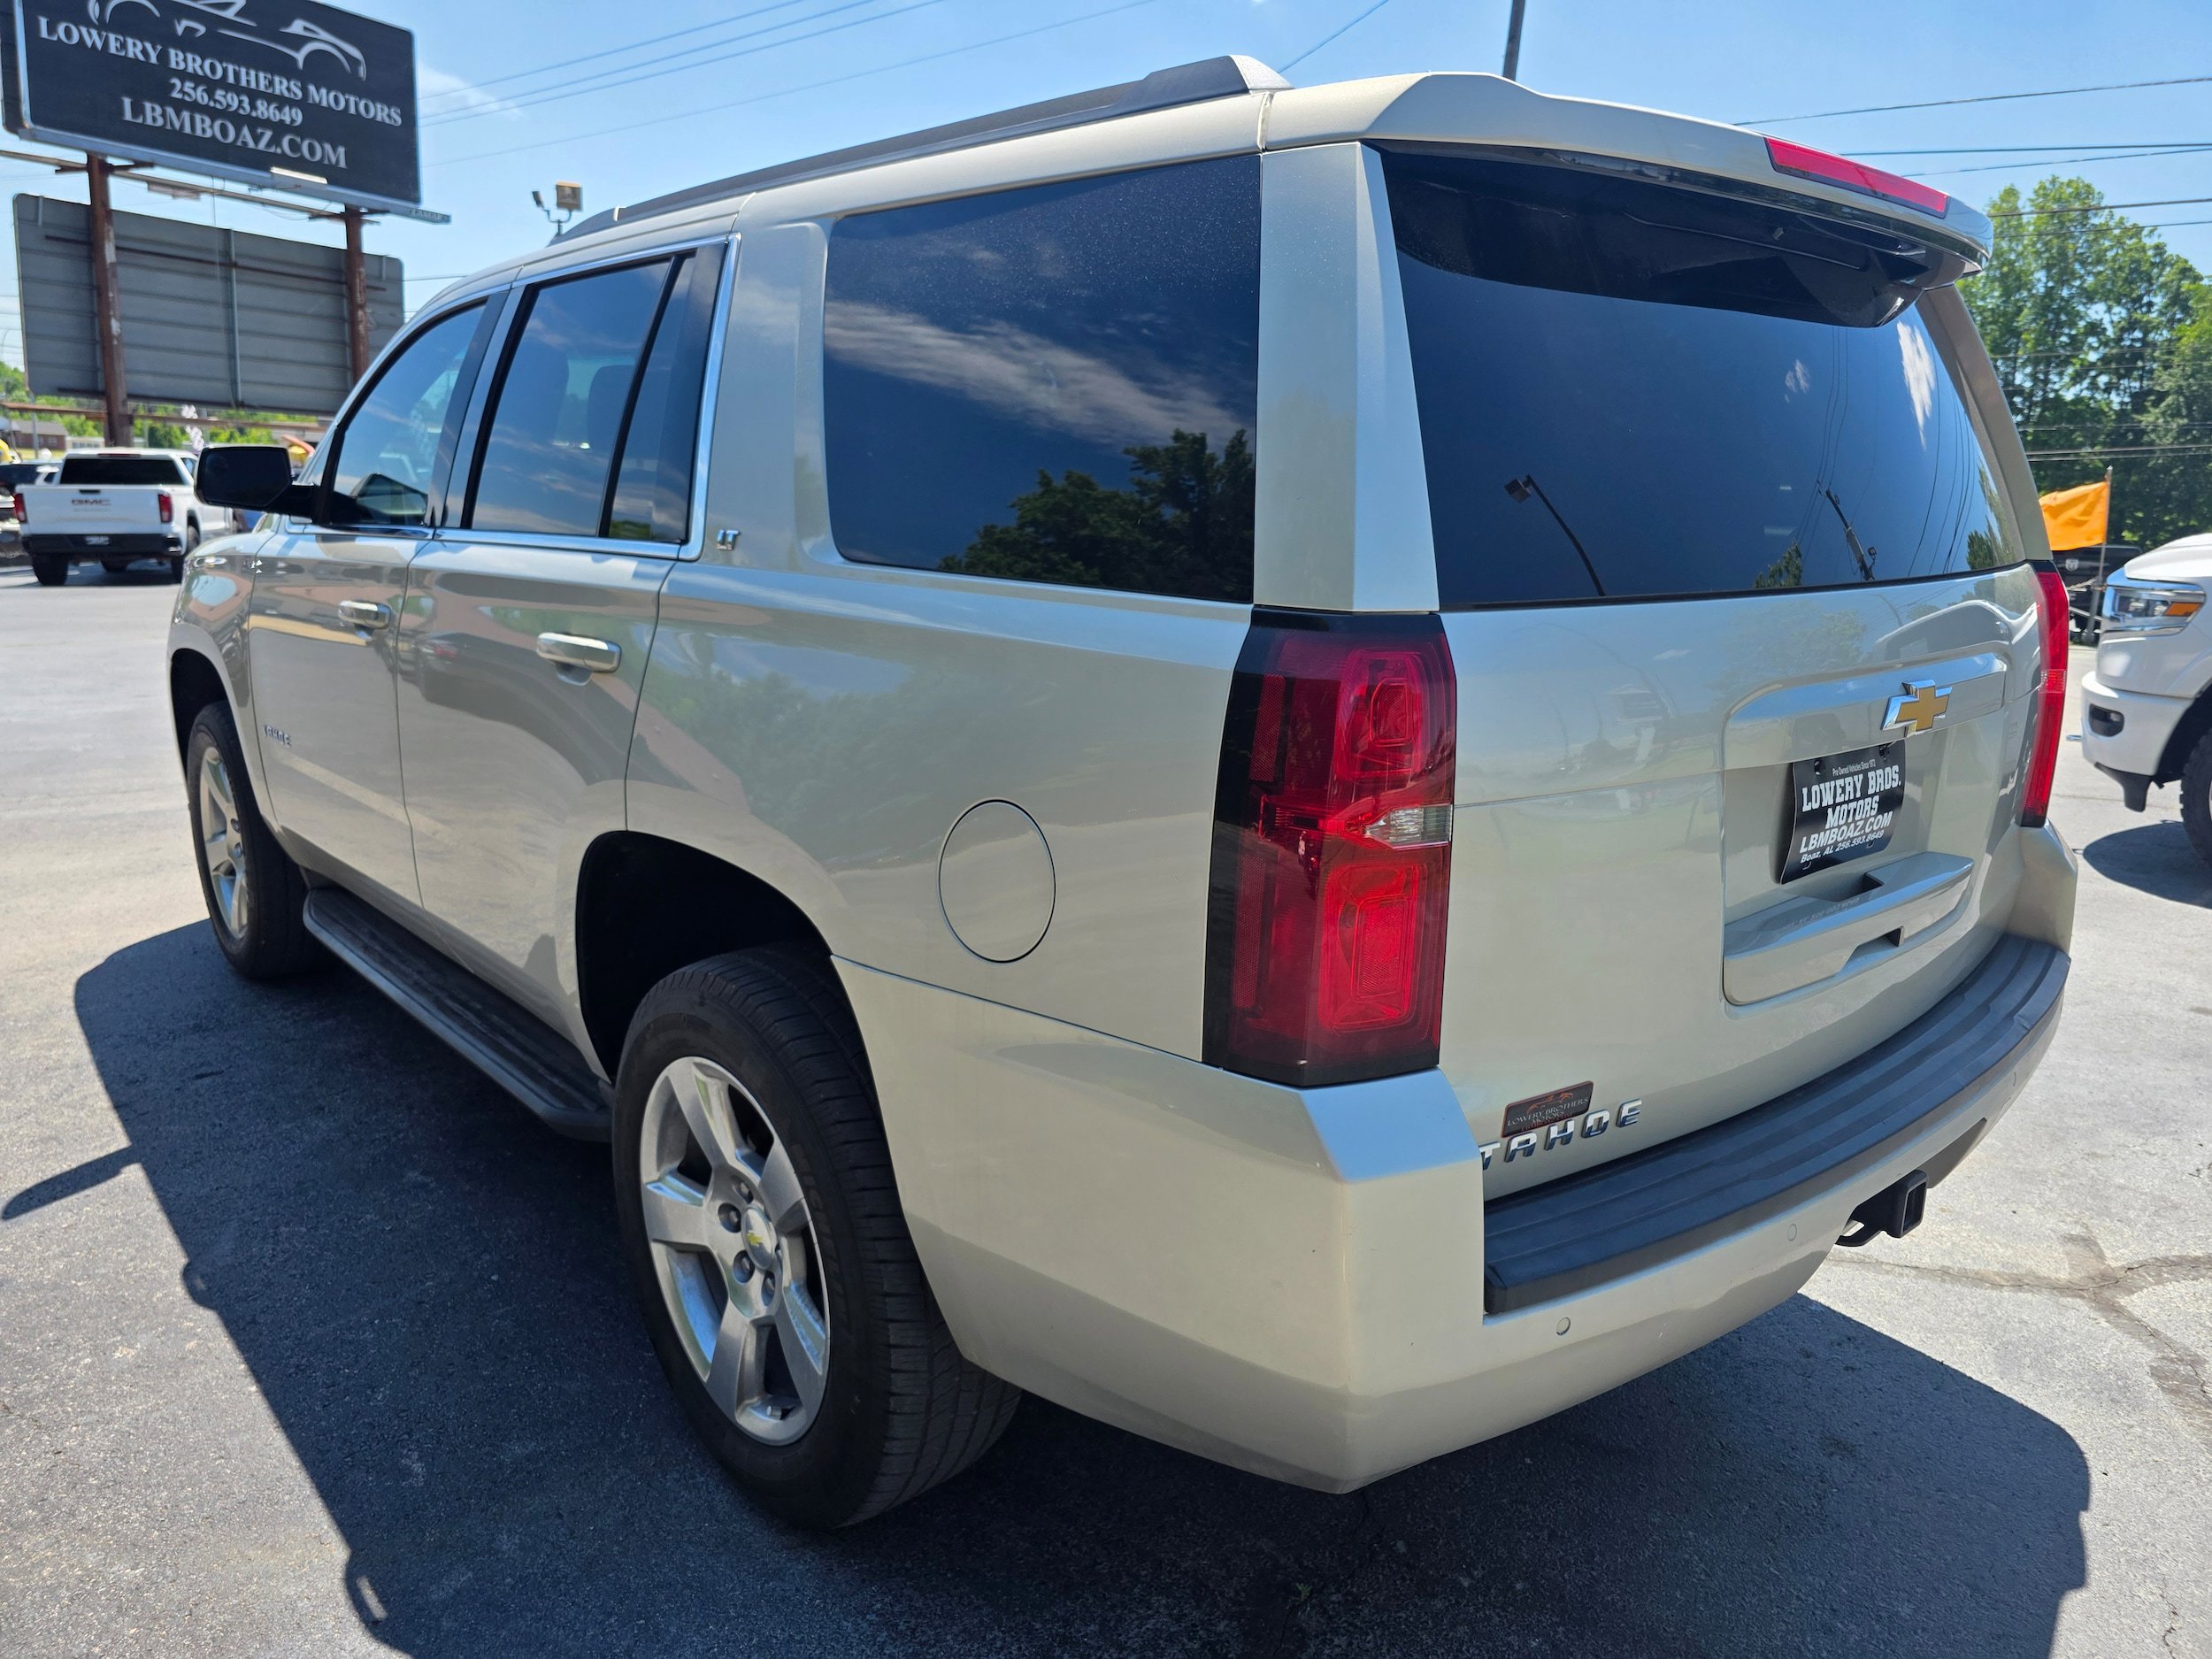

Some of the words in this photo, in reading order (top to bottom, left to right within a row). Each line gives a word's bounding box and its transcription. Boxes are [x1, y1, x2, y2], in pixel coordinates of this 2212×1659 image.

[38, 15, 162, 65] LOWERY
[168, 47, 303, 100] BROTHERS
[307, 82, 403, 127] MOTORS
[169, 77, 303, 127] 256.593.8649
[120, 96, 348, 169] LBMBOAZ.COM
[71, 498, 111, 507] GMC
[717, 529, 741, 550] LT
[1802, 774, 1863, 812] LOWERY
[1868, 764, 1901, 795] BROS.
[1799, 811, 1893, 853] LBMBOAZ.COM
[1825, 795, 1879, 829] MOTORS
[1823, 845, 1834, 856] AL
[1835, 829, 1885, 852] 256.593.8649
[1508, 1110, 1542, 1126] LOWERY
[1545, 1096, 1589, 1115] BROTHERS
[1479, 1098, 1642, 1171] TAHOE
